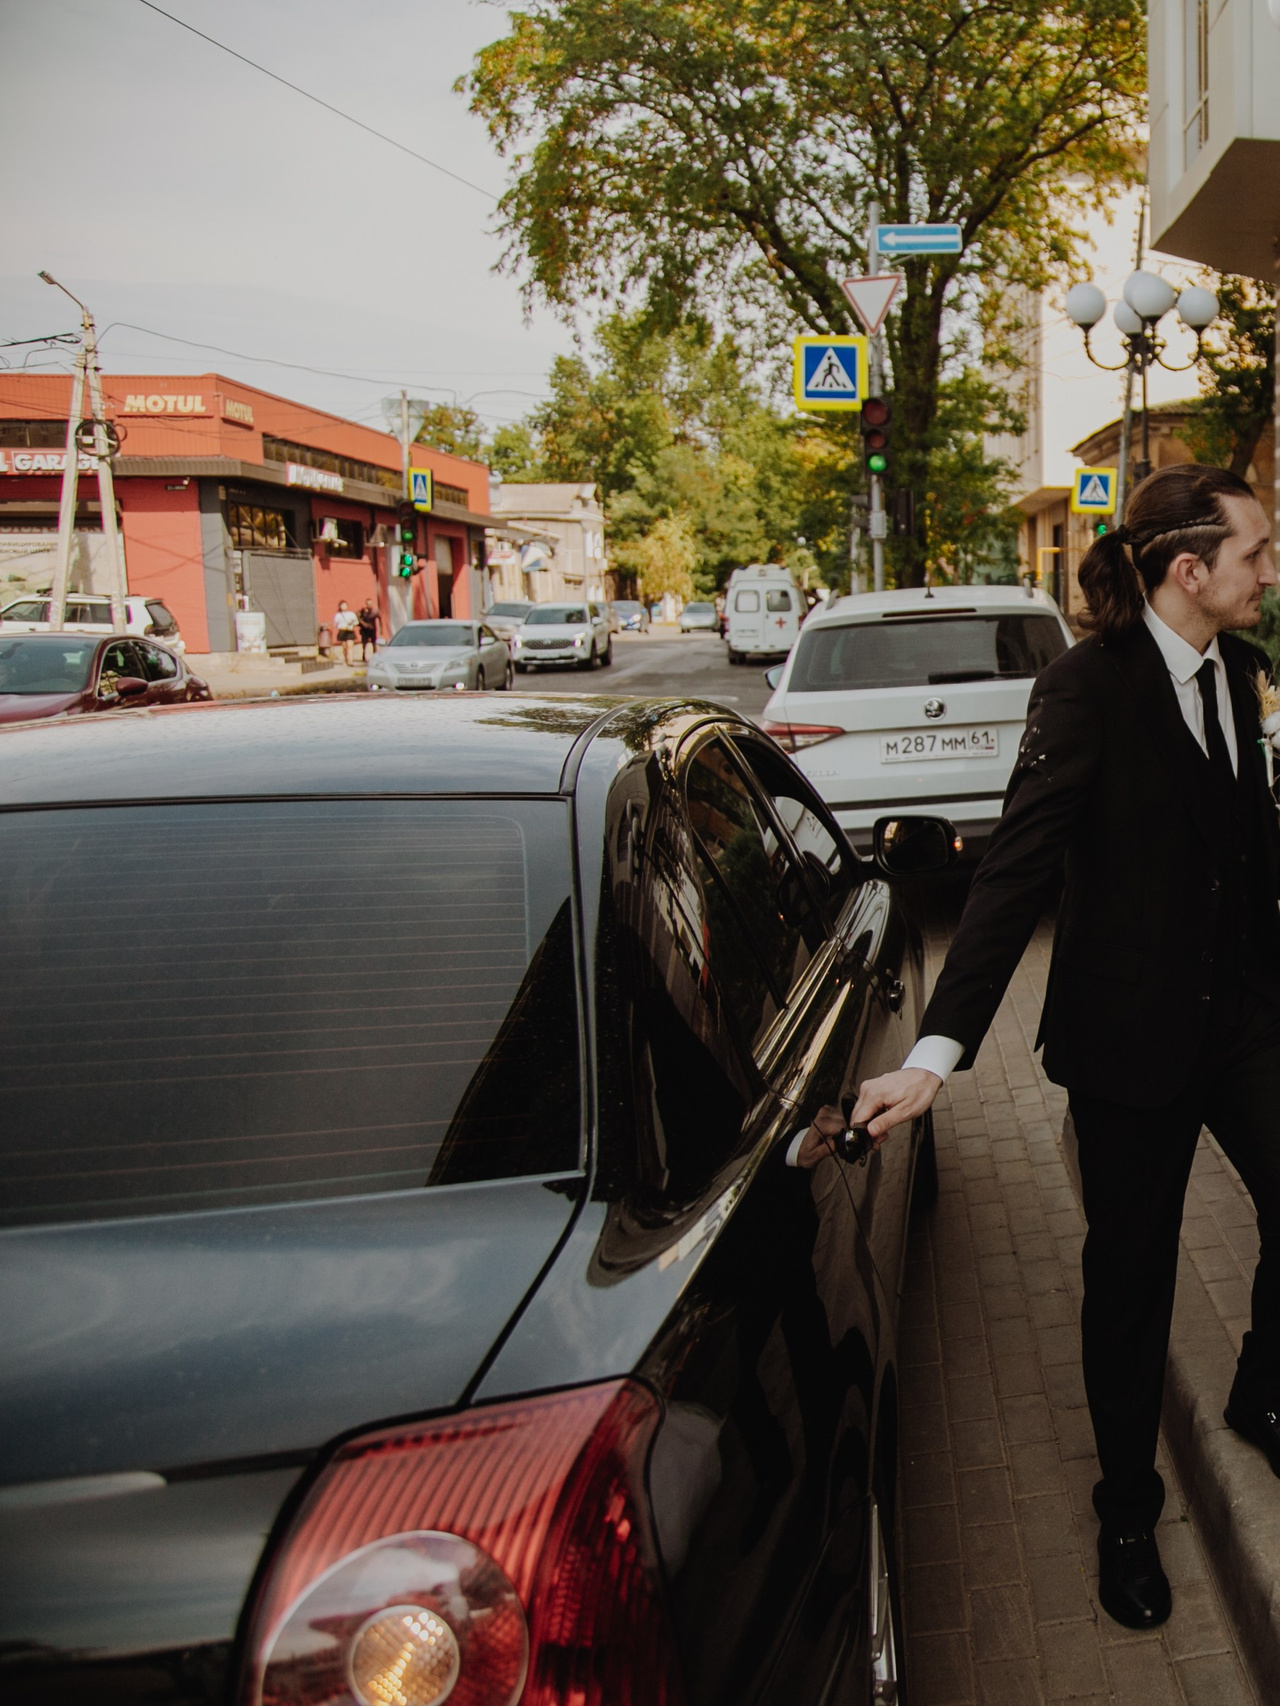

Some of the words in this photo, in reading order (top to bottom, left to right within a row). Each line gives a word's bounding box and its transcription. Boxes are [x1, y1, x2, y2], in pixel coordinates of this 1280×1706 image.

[123, 394, 206, 413] MOTUL
[225, 398, 254, 423] MOTUL
[15, 453, 100, 471] GARGE
[971, 731, 989, 745] 61
